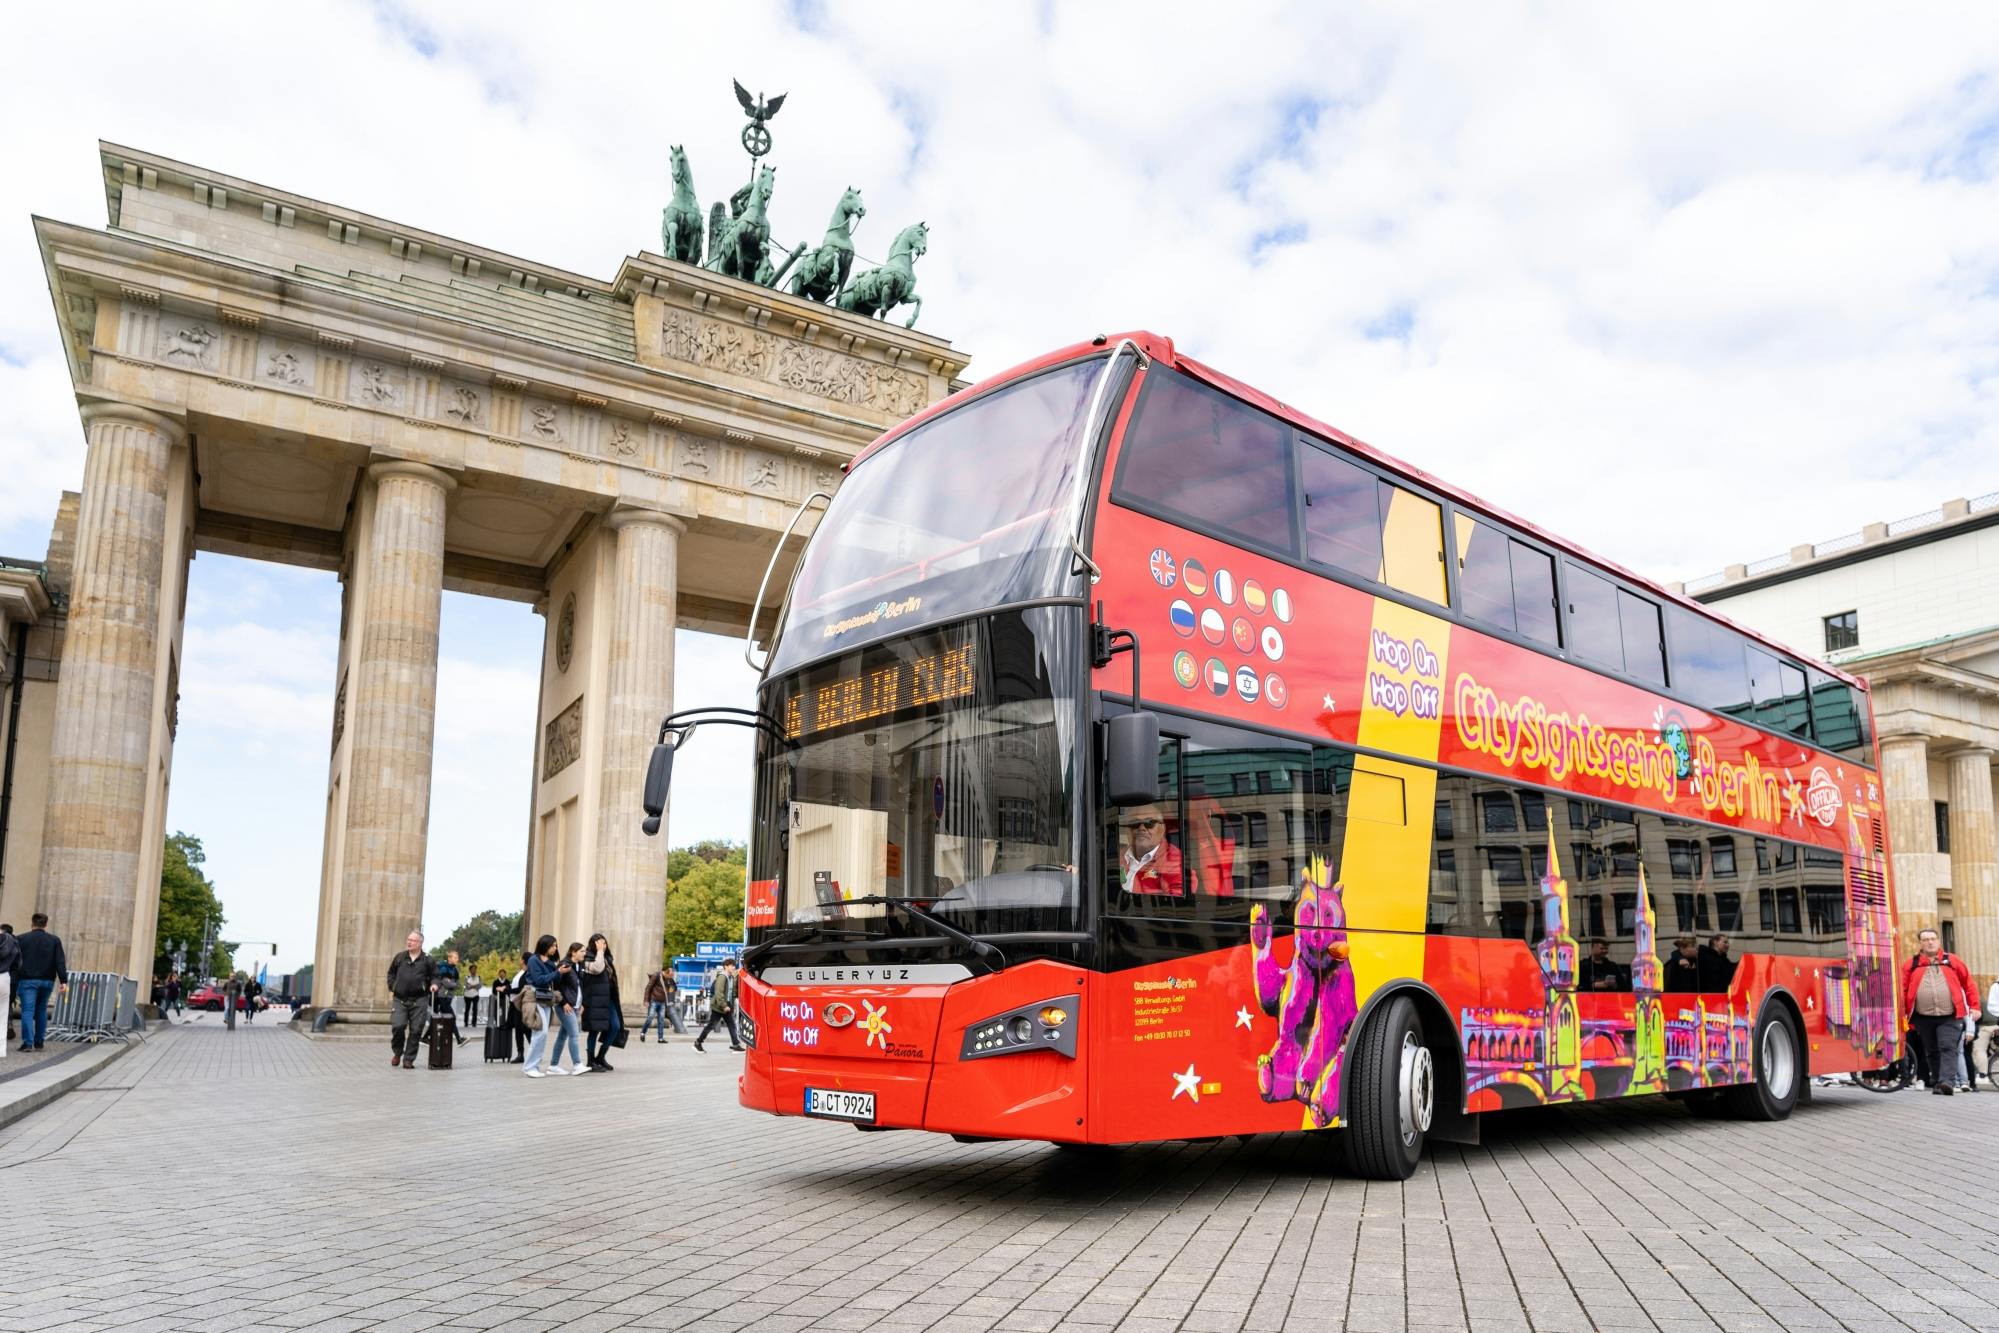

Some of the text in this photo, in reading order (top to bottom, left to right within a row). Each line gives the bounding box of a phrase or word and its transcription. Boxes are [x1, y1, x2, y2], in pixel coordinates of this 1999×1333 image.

[1372, 629, 1439, 678] Hop On
[1370, 671, 1439, 720] Hop Off
[1454, 672, 1781, 825] CitySightseeing Berlin
[715, 946, 735, 954] HALL
[780, 1001, 814, 1021] Hop On
[783, 1026, 819, 1046] Hop Off
[885, 1042, 924, 1058] Panora
[812, 1091, 873, 1116] B CT 9924
